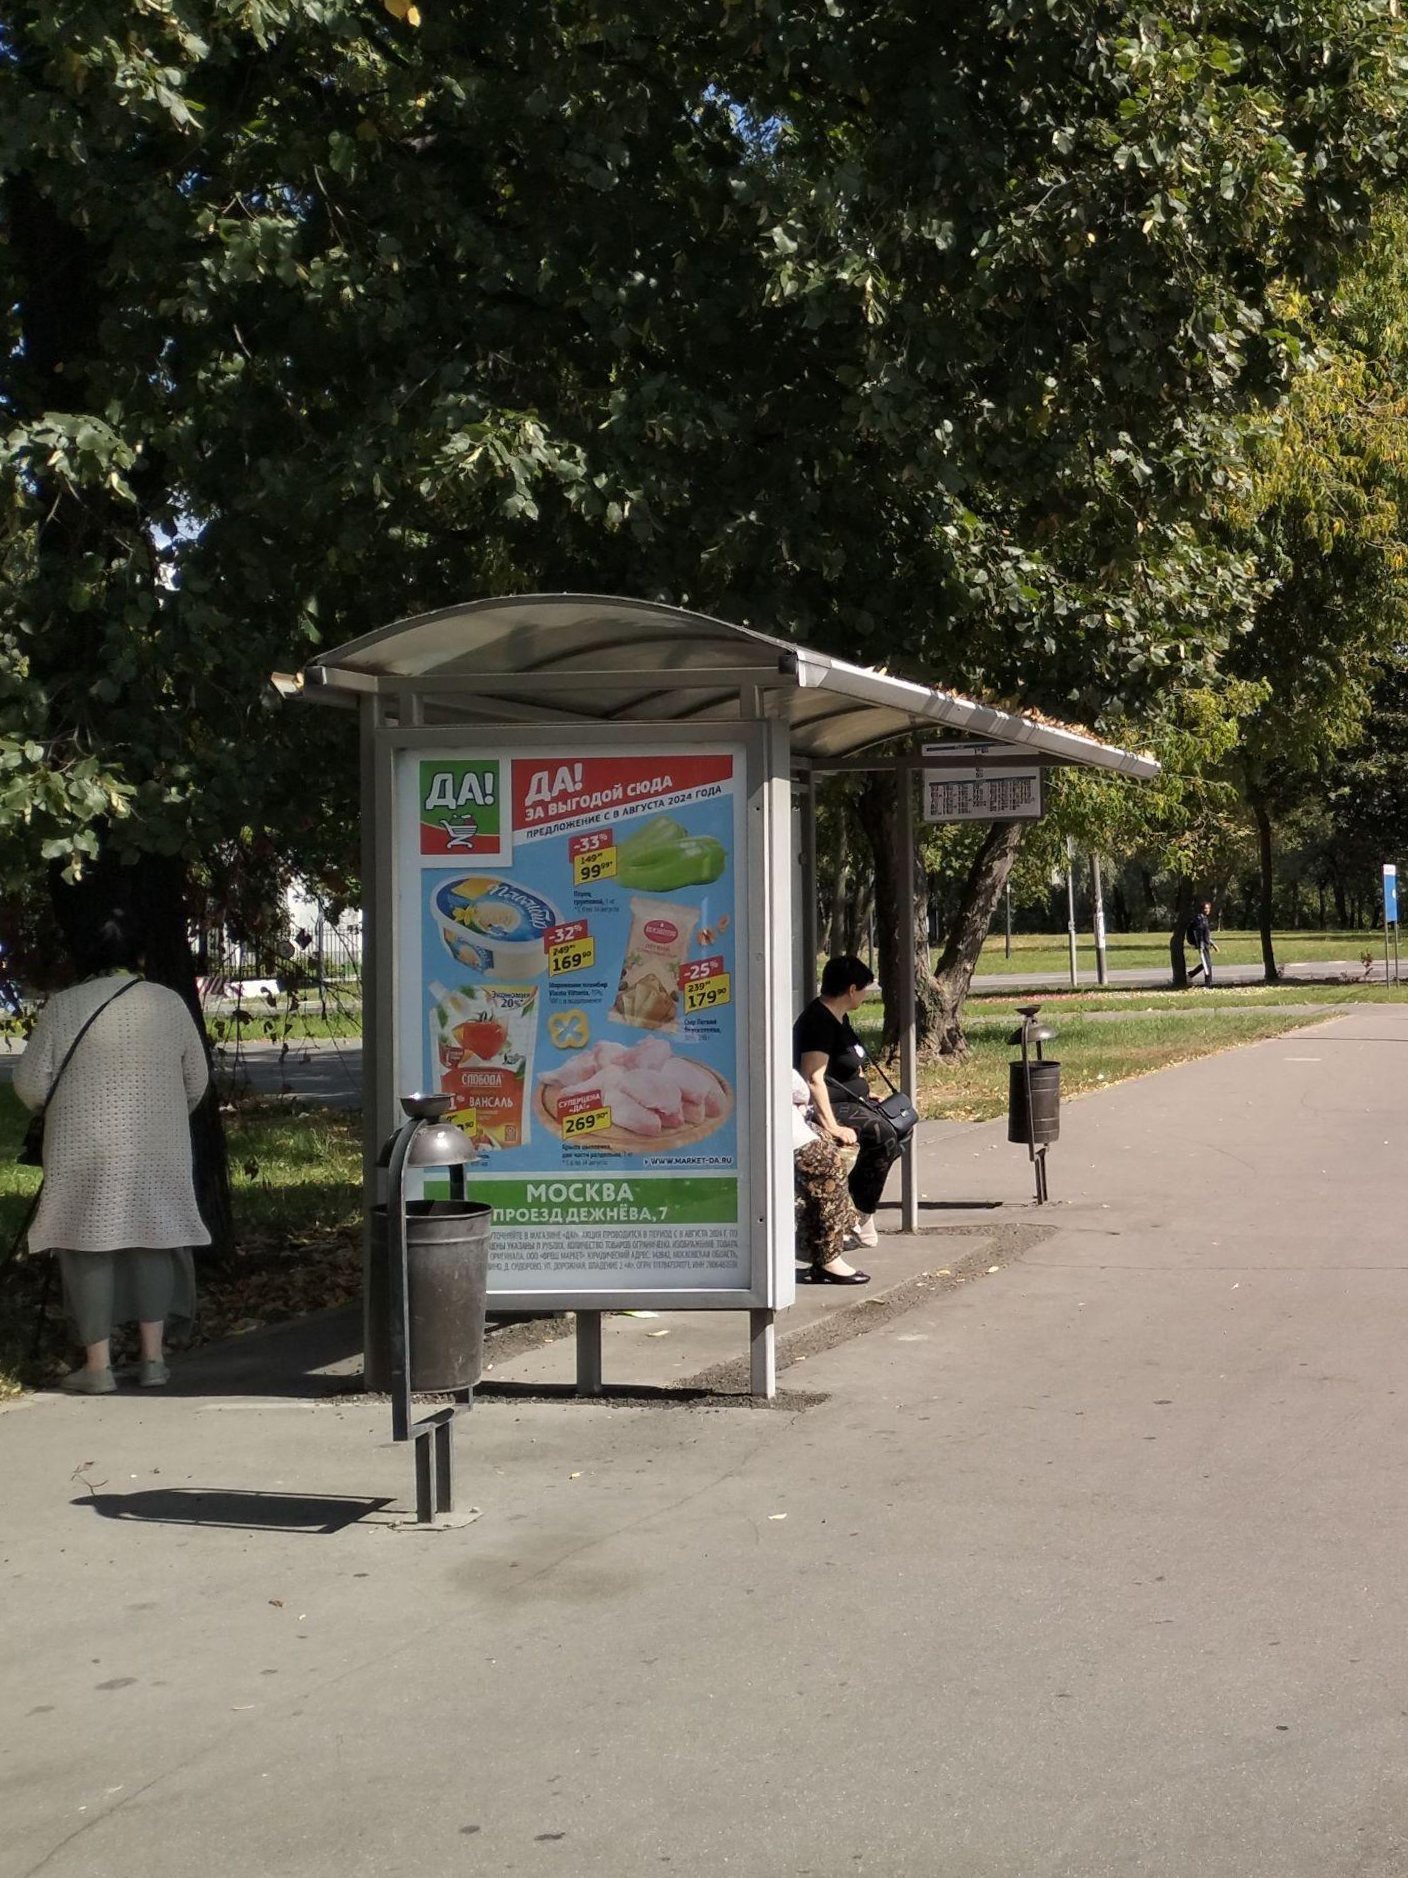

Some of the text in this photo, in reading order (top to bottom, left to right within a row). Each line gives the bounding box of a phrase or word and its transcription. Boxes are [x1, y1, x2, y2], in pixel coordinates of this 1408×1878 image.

[426, 772, 495, 810] ДА!
[525, 763, 583, 807] ДА!
[525, 775, 673, 821] ЗА ВЫГОДОЙ СЮДА
[526, 814, 601, 839] ПРЕДЛОЖЕНИЕ
[603, 811, 610, 821] С
[622, 800, 665, 816] АВГУСТА
[668, 793, 692, 806] 2024
[695, 784, 722, 799] ГОДА
[650, 1157, 733, 1166] WWW.MARKET-DA.RU
[526, 1182, 634, 1203] МОСКВА
[493, 1207, 563, 1225] ПРОЕЗД
